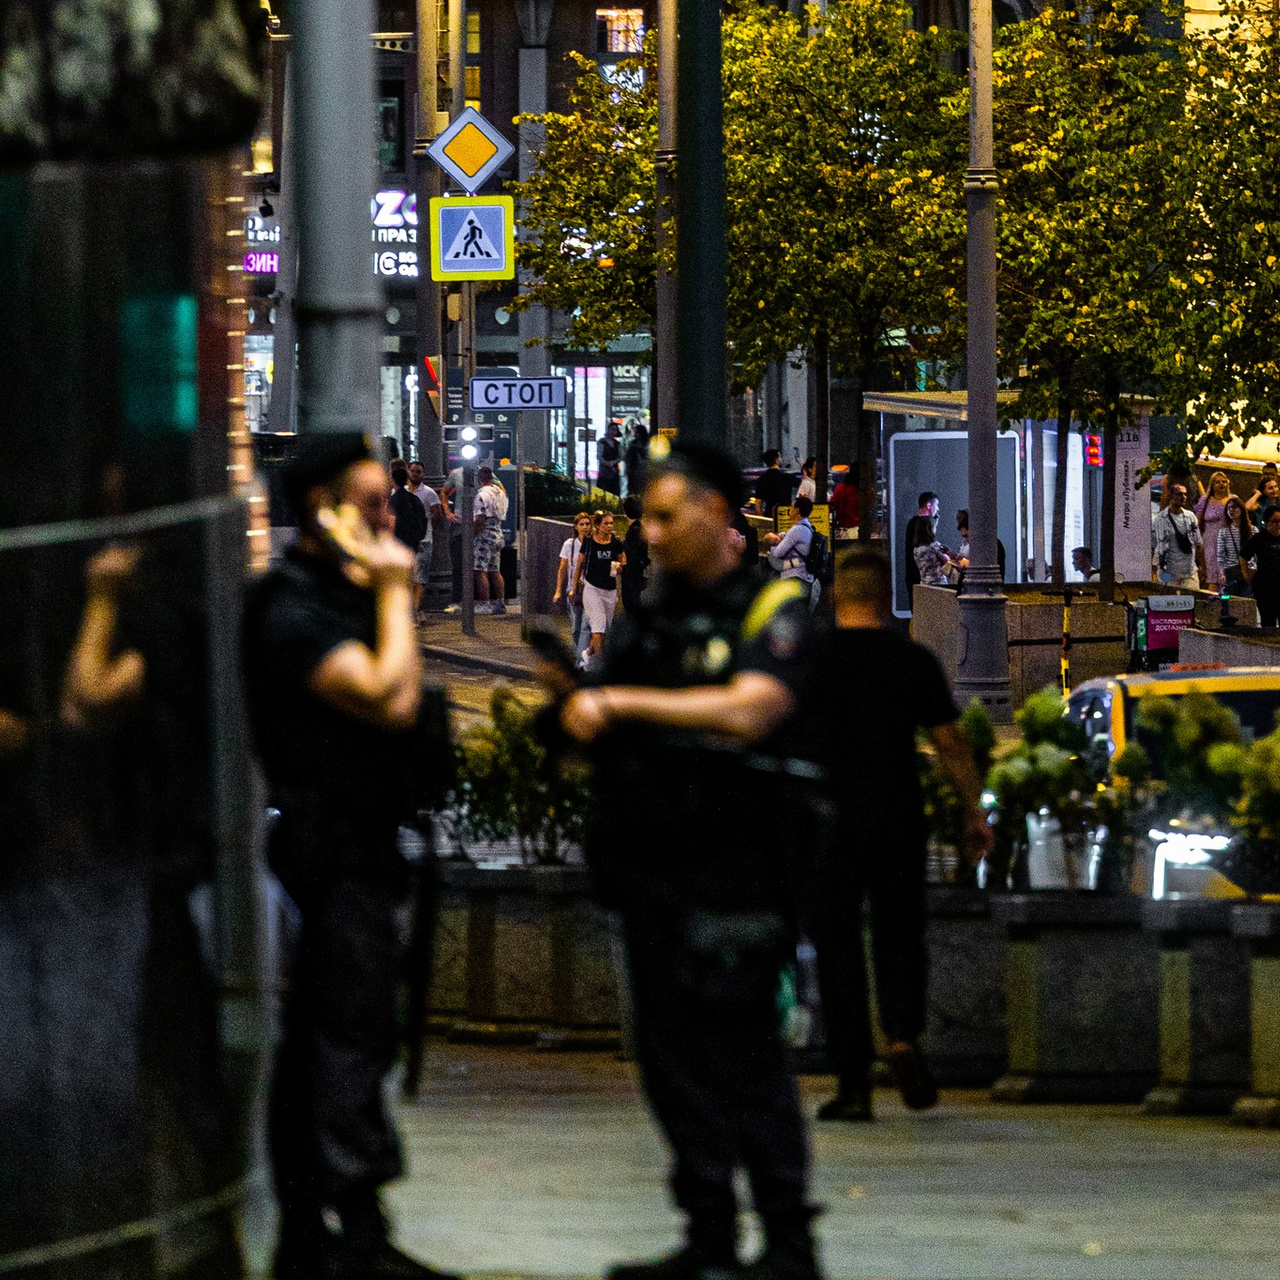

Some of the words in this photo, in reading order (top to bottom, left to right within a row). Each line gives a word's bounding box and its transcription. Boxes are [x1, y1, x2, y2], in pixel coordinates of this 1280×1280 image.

[244, 253, 280, 273] ЗИН
[484, 383, 553, 405] СТОП
[1122, 503, 1131, 529] Метро
